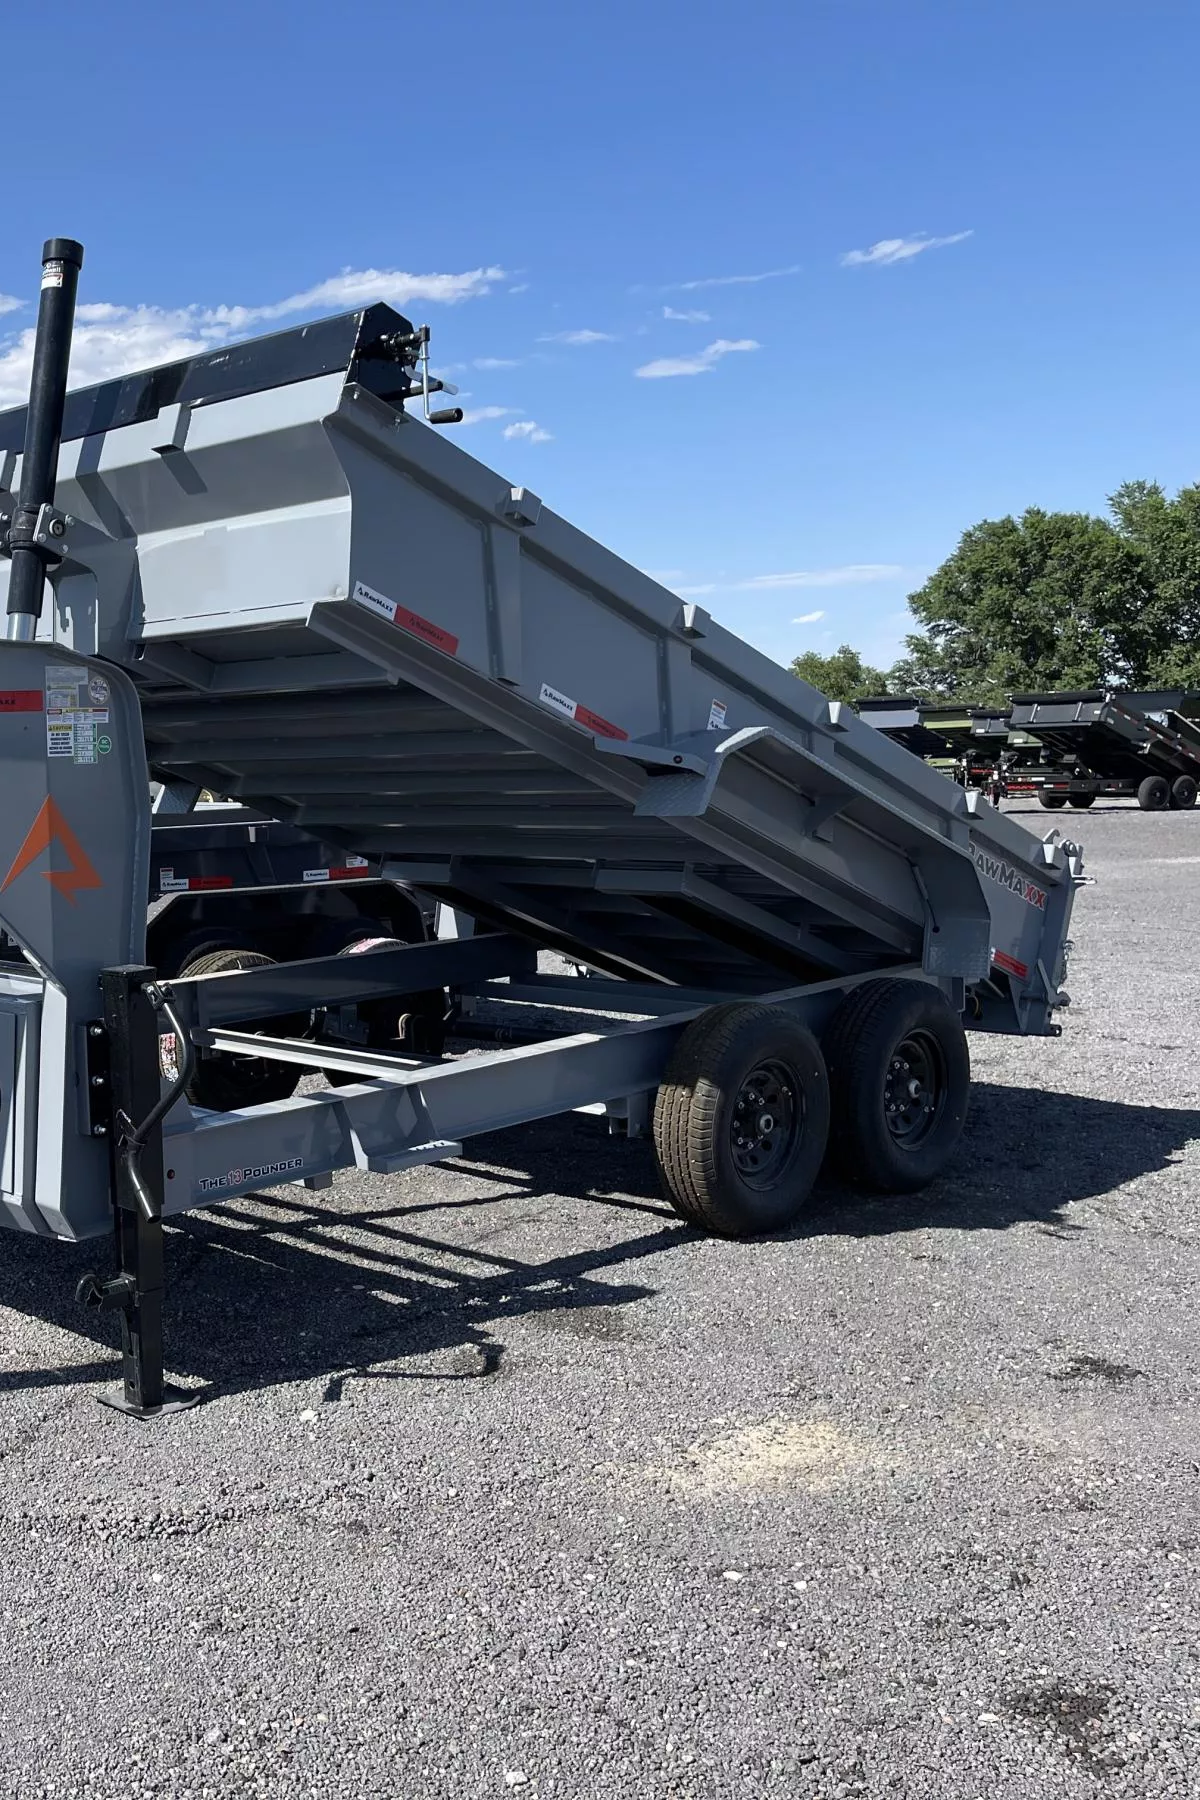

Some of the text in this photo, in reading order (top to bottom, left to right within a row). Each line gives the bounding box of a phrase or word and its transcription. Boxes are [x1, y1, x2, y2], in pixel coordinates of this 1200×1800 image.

[199, 1157, 304, 1192] THE 13 POUNDER
